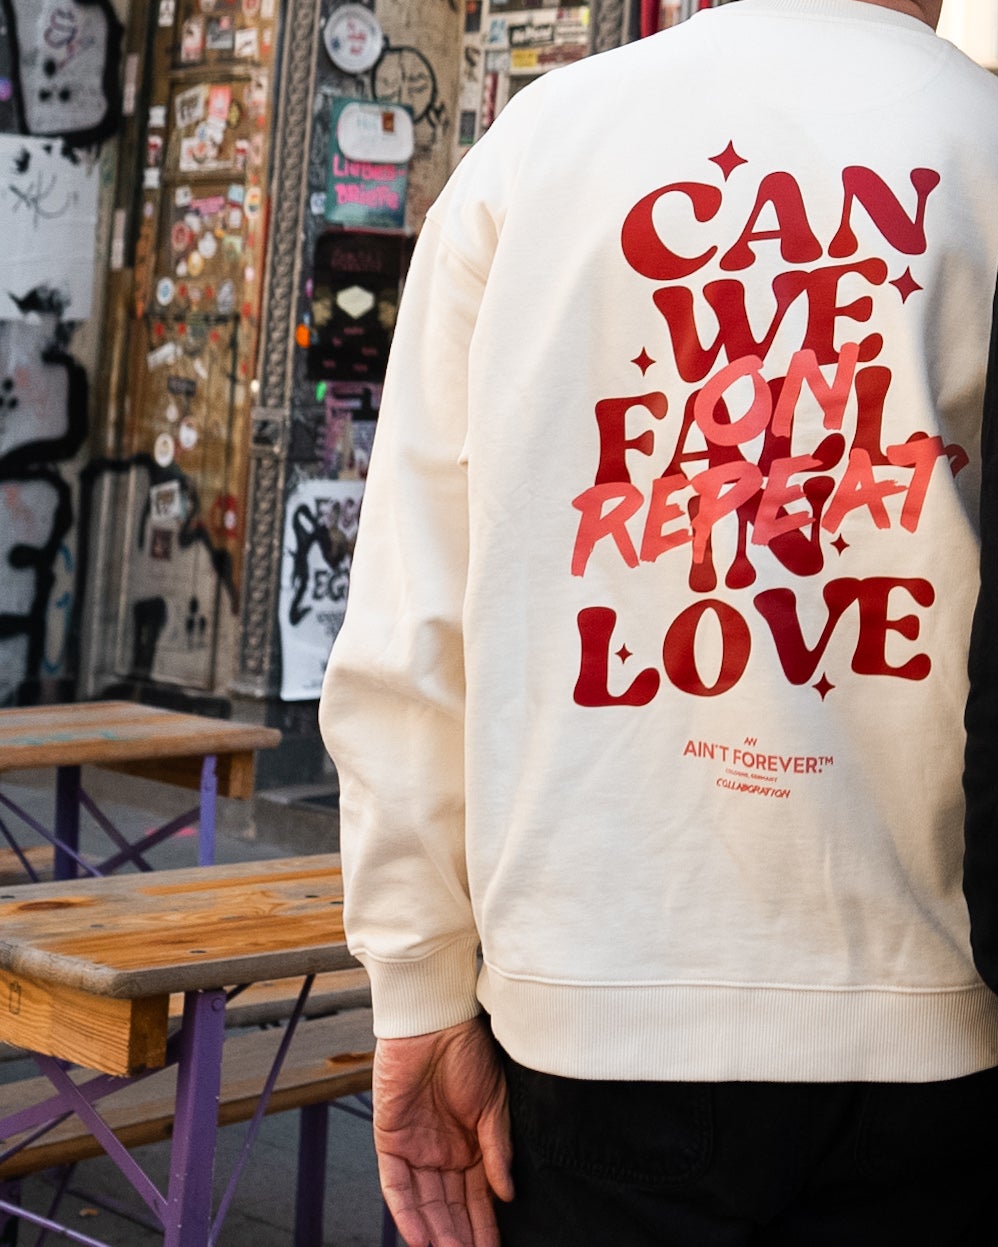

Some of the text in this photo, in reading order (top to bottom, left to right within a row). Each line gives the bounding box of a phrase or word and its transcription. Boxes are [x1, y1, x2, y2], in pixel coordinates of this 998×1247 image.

[621, 165, 940, 280] CAN
[652, 257, 888, 383] WE
[693, 341, 860, 446] ON
[571, 436, 948, 578] REPEAT
[573, 576, 935, 708] LOVE
[683, 740, 729, 762] AIN'T
[716, 777, 791, 799] COLLABORATION
